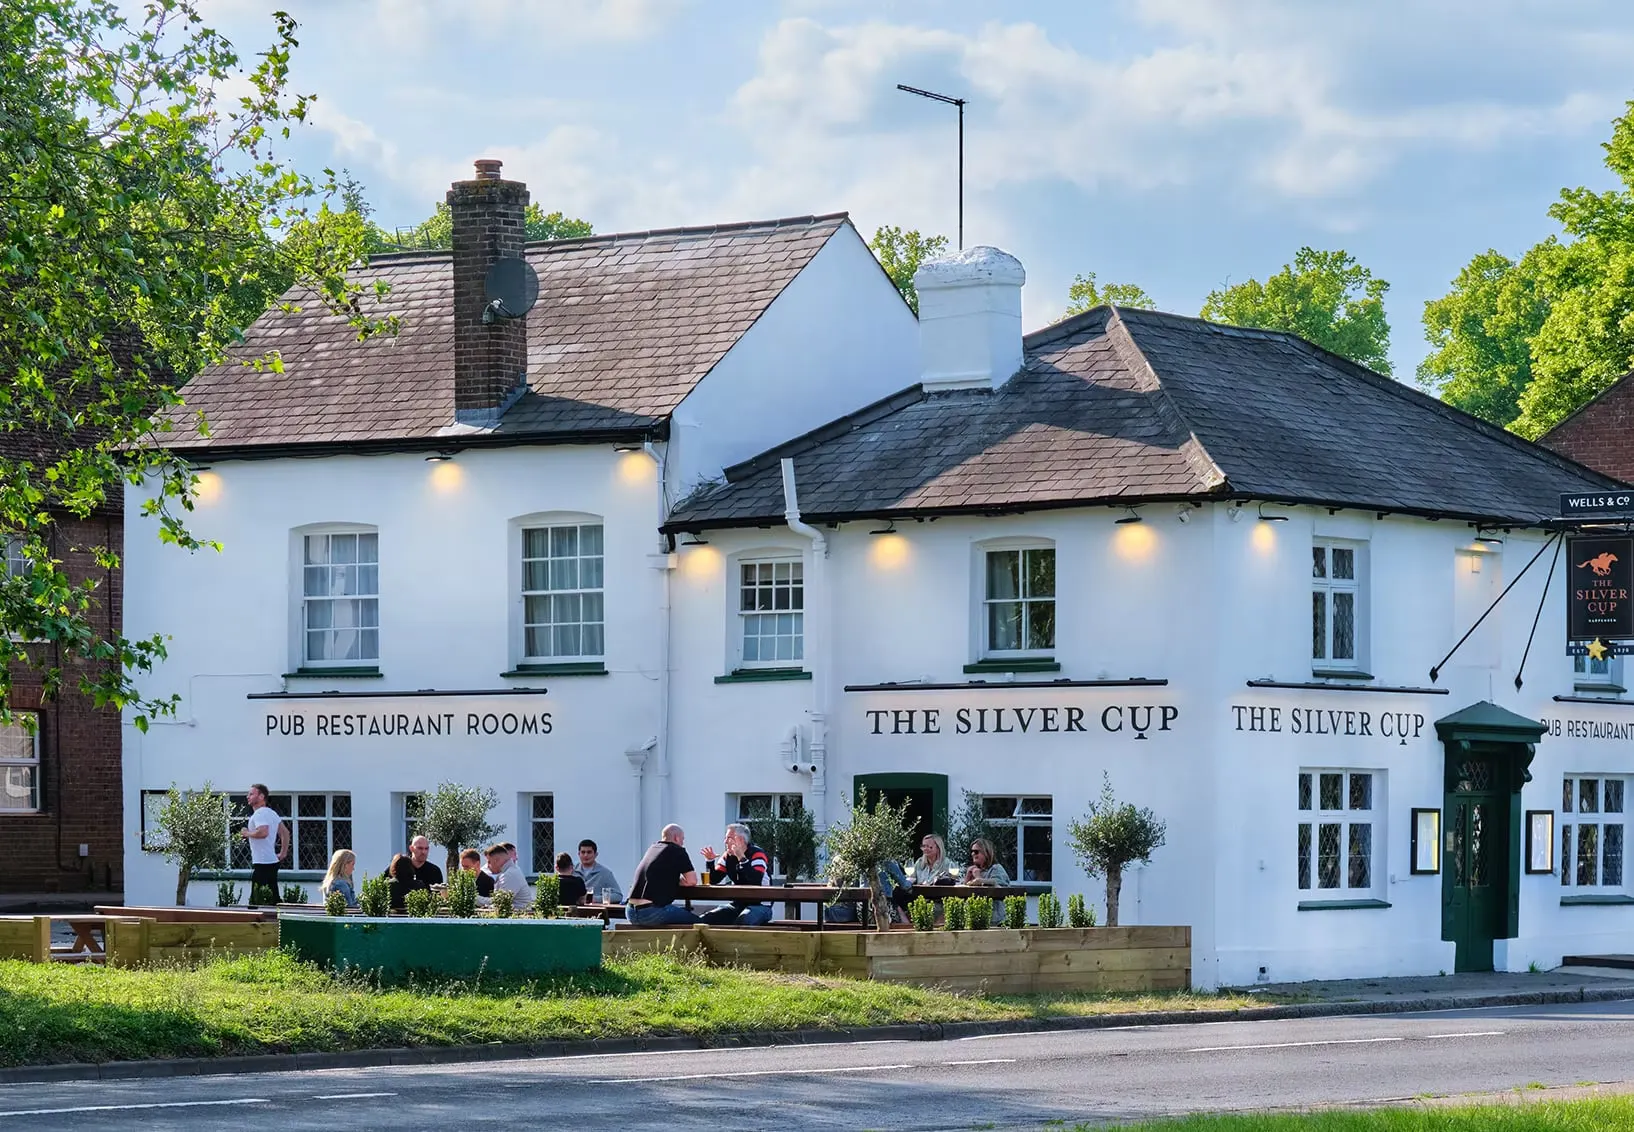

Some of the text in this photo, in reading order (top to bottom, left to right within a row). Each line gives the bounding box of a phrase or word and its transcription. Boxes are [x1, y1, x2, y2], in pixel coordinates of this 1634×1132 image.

[1568, 497, 1605, 507] WELLS
[1607, 496, 1614, 506] &
[1576, 588, 1628, 600] SILVER
[1587, 601, 1617, 615] CUP
[265, 712, 553, 736] PUB RESTAURANT ROOMS
[865, 705, 1179, 740] THE SILVER CUP
[1231, 705, 1425, 745] THE SILVER CUP
[1567, 720, 1634, 741] RESTAURANT
